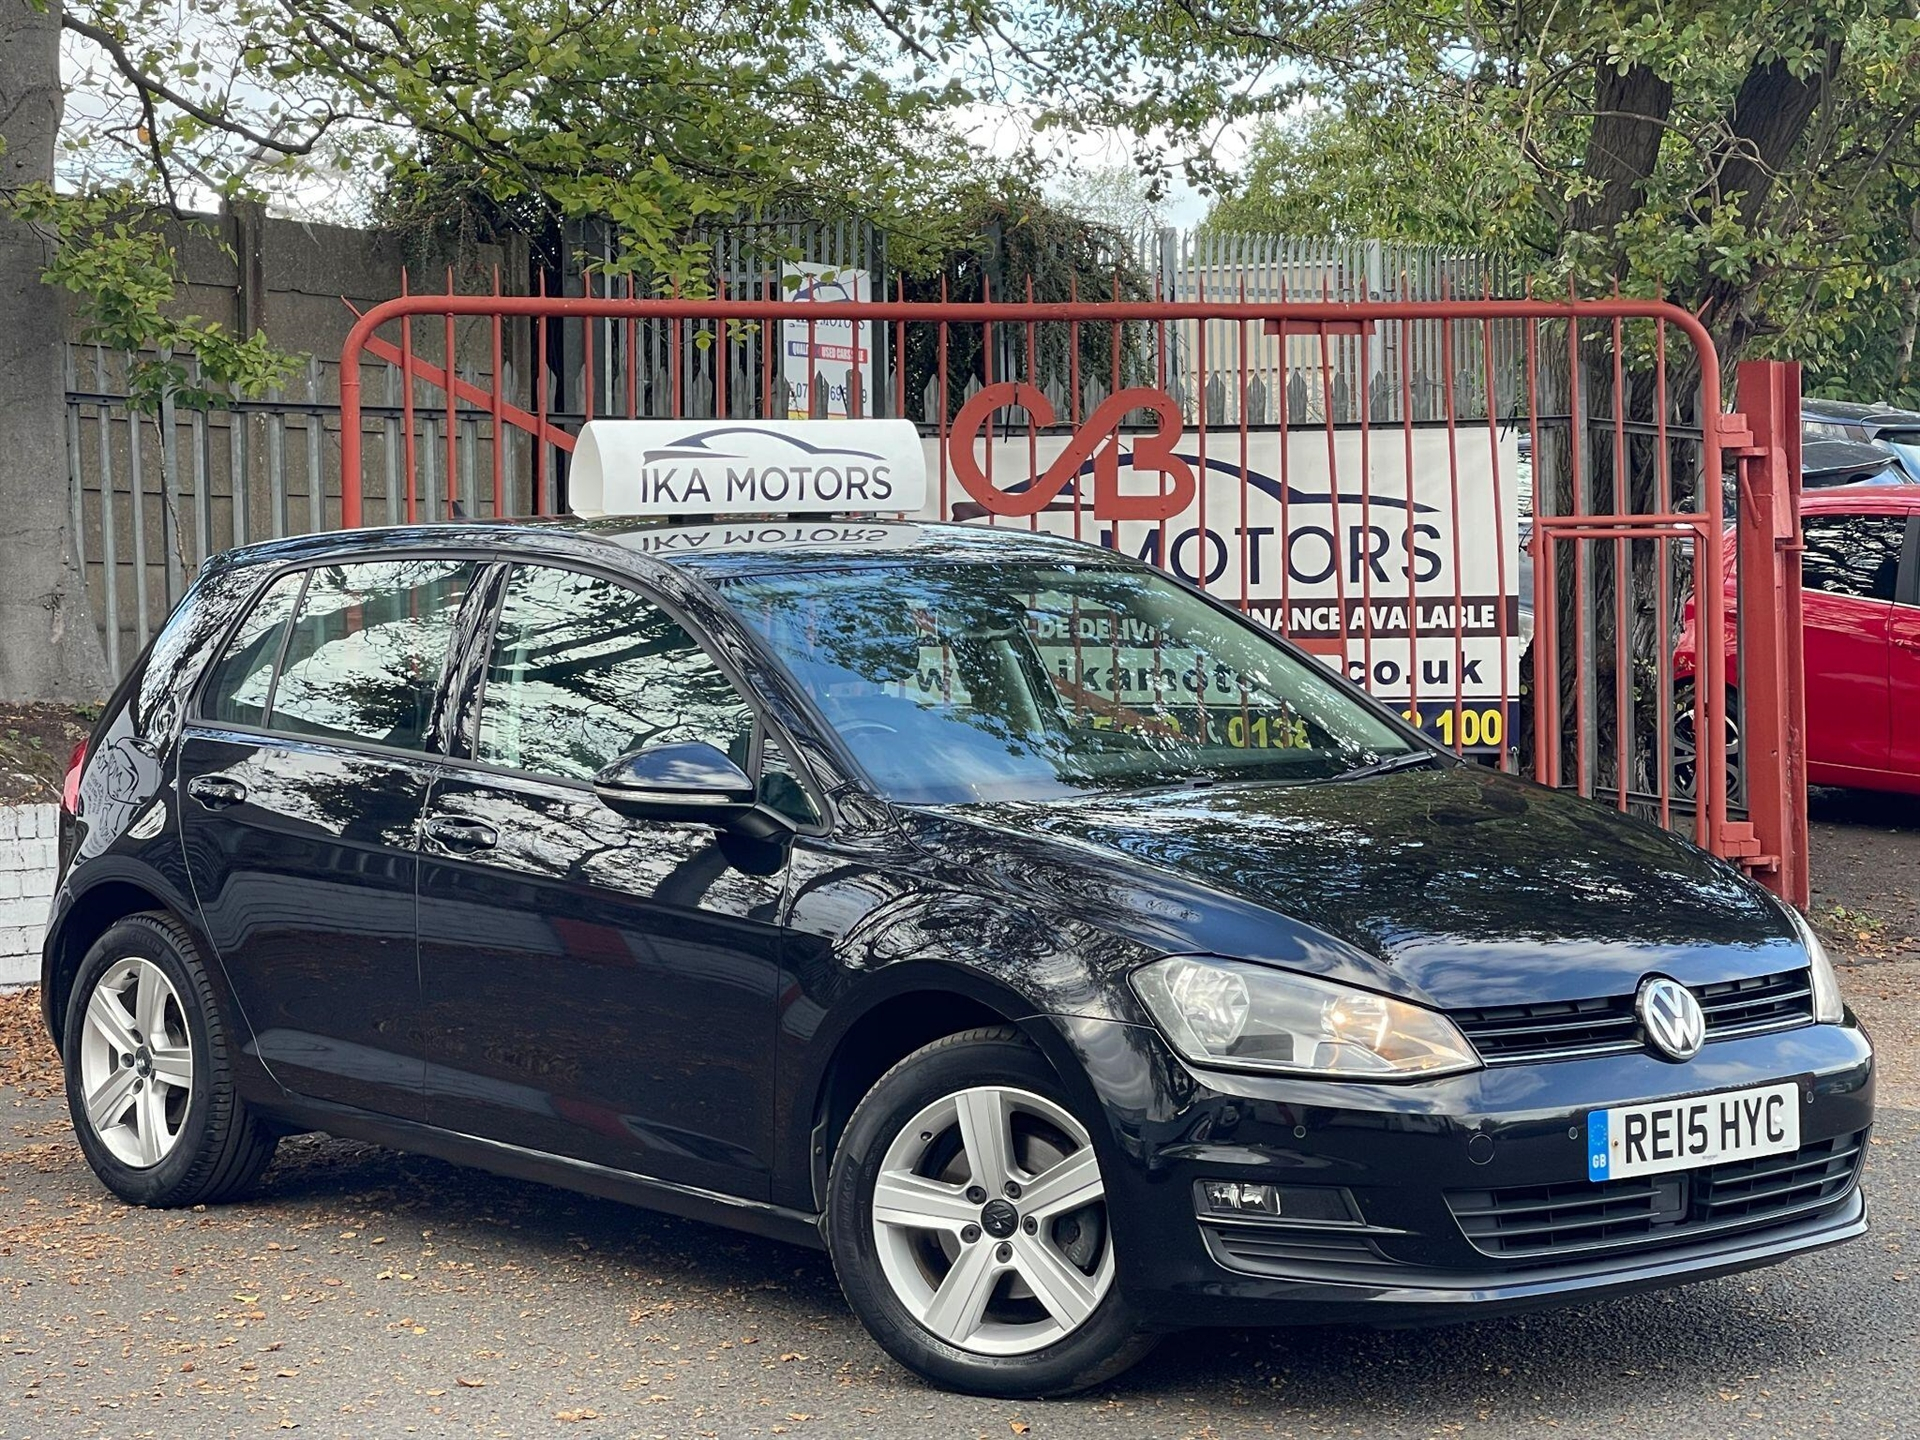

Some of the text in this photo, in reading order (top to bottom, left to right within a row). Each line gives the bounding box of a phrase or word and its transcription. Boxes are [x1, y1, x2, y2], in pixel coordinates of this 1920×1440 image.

[641, 466, 892, 503] IKA MOTORS
[1239, 607, 1341, 631] NANCE
[1436, 709, 1503, 746] 100
[1625, 1094, 1785, 1164] RE15 HYC
[1592, 1153, 1607, 1169] GB
